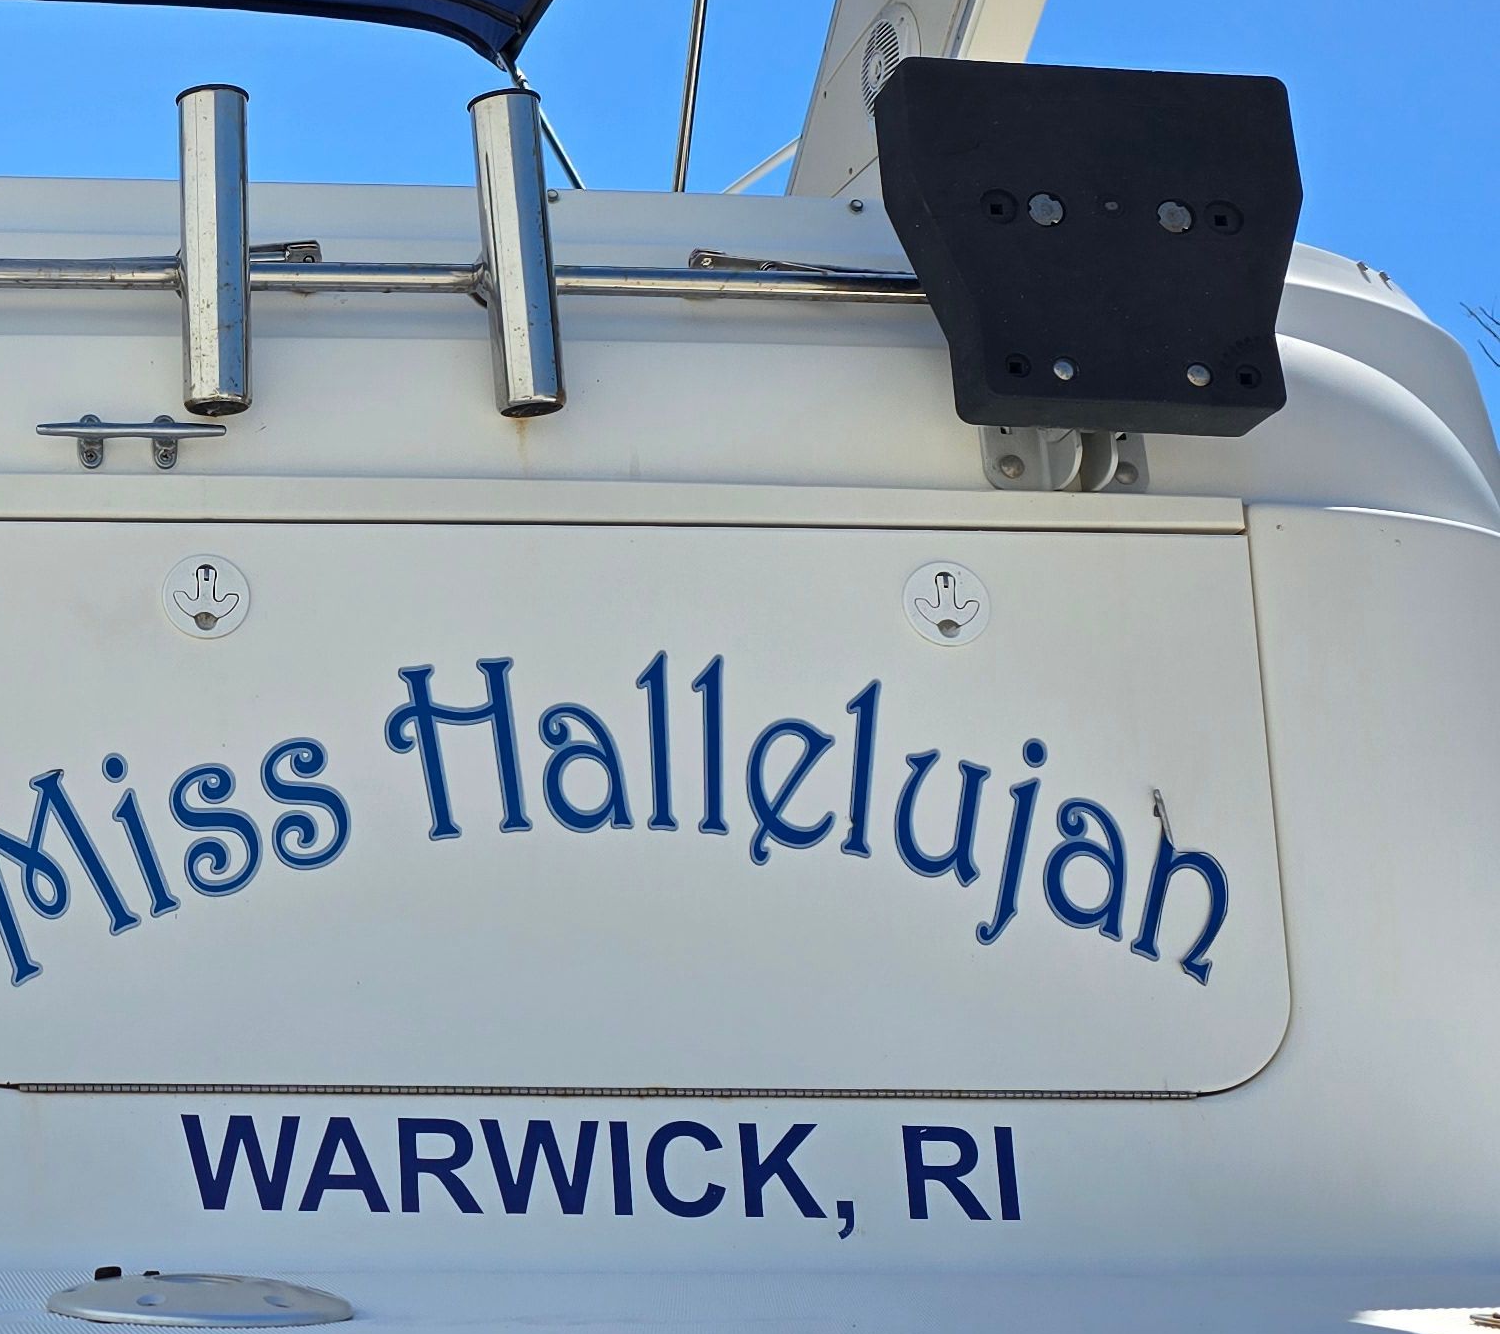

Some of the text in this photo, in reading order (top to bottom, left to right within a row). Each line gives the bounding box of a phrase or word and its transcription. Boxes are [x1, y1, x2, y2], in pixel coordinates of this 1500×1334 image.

[383, 649, 1232, 988] Hallelujah
[180, 1113, 1022, 1240] WARWICK, RI
